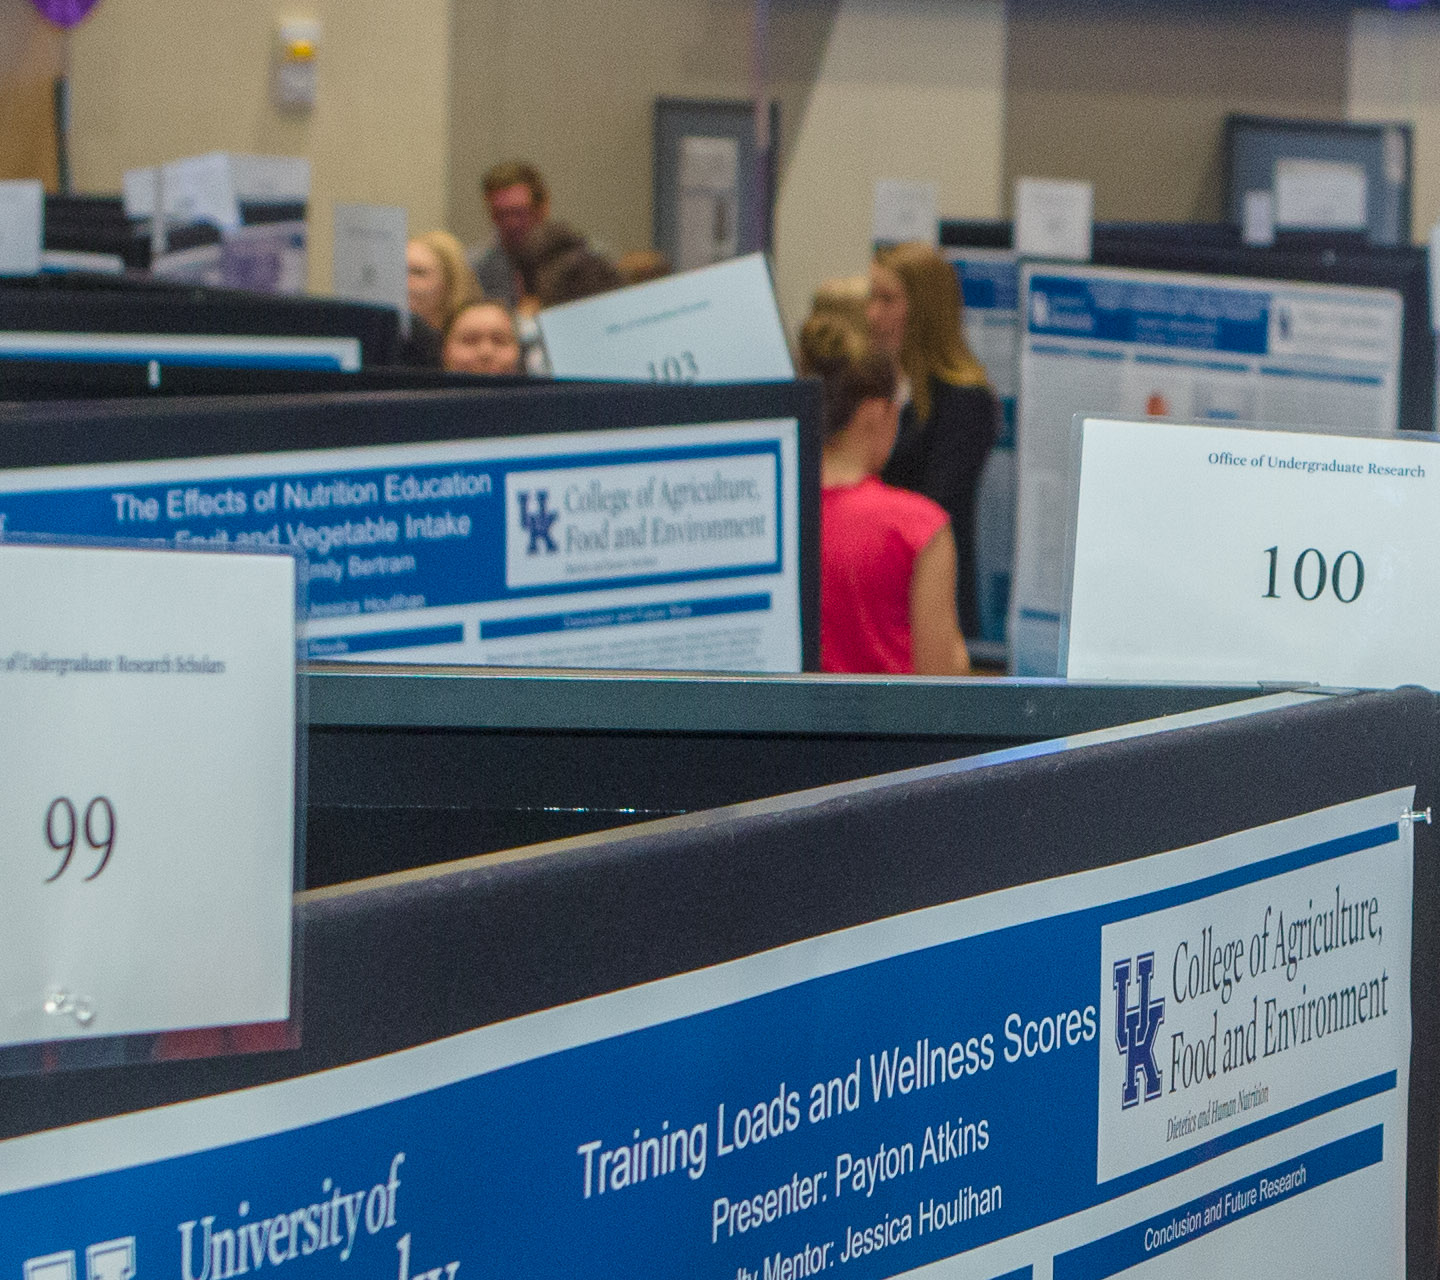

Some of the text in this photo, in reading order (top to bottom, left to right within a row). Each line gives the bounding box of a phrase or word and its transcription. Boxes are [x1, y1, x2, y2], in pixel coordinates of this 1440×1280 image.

[646, 351, 700, 382] 103
[113, 471, 493, 523] The Effects of Nutrition Education
[564, 471, 763, 517] College of Agriculture,
[1208, 451, 1426, 478] Office of Undergraduate Research
[237, 511, 472, 553] and Vegetable Intake
[565, 513, 767, 553] Food and Environment
[1261, 545, 1366, 604] 100
[6, 651, 20, 672] of
[21, 652, 113, 676] Undergraduate
[117, 655, 171, 674] Research
[175, 656, 227, 675] Scholars
[44, 795, 117, 884] 99
[1172, 884, 1383, 1006] College of Agriculture,
[1168, 969, 1389, 1095] Food and Environment
[576, 1004, 1097, 1199] Training Loads and Wellness Scores
[360, 1152, 406, 1235] of
[711, 1119, 990, 1244] Presenter: Payton Atkins
[1143, 1163, 1307, 1252] Conclusion and Future Research
[839, 1213, 913, 1264] Jessica
[918, 1184, 1003, 1236] Houlihan
